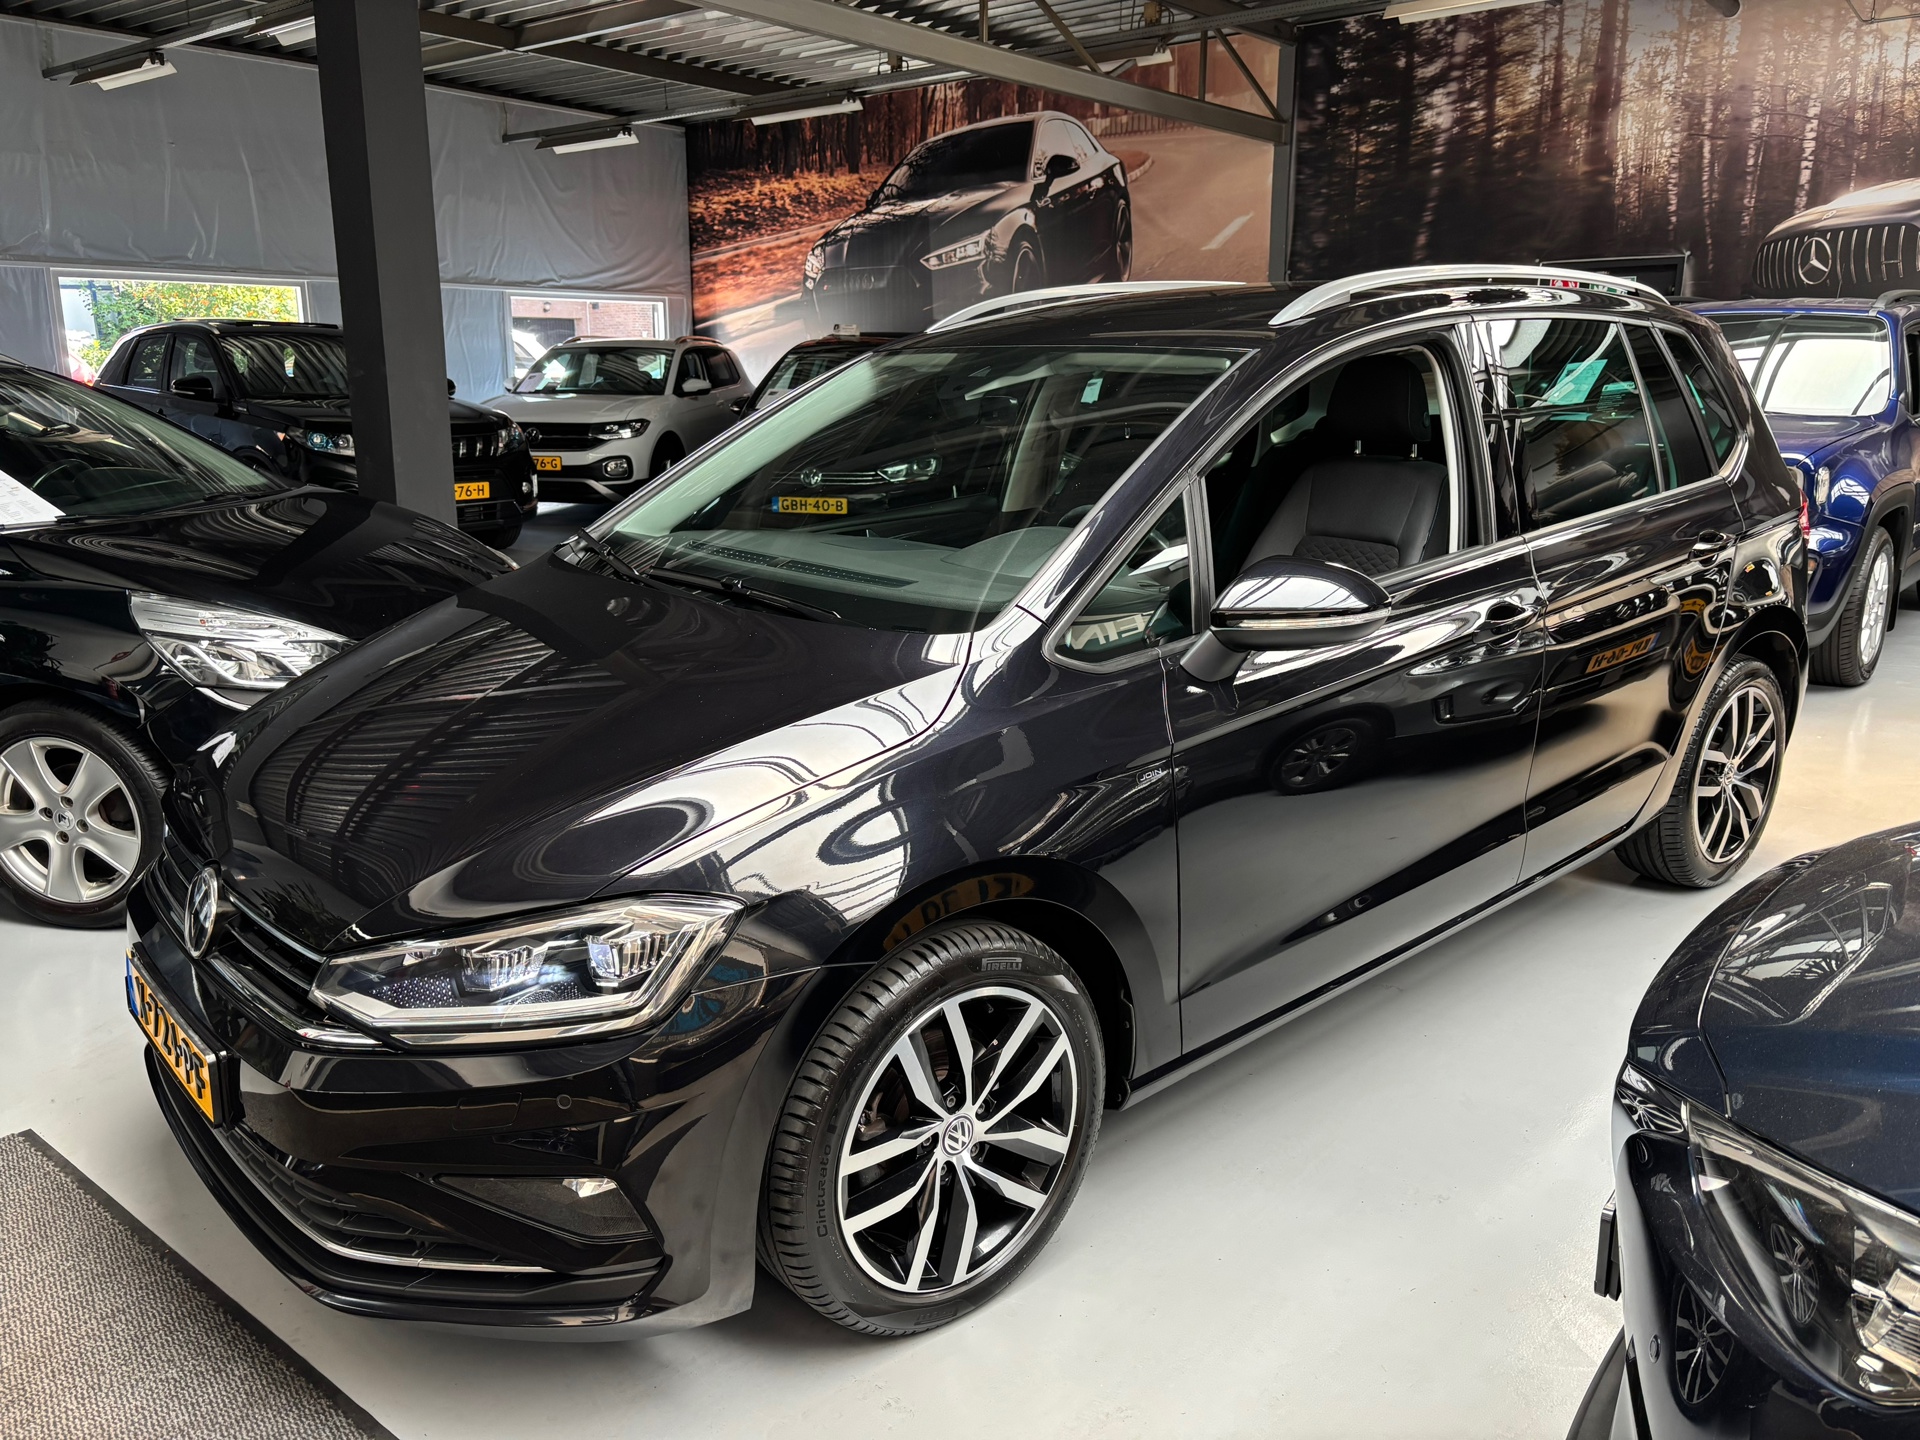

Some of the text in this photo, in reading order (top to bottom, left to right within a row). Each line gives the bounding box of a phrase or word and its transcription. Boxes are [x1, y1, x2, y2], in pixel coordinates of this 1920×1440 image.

[781, 498, 844, 512] GBH-40-B
[1139, 767, 1163, 782] JOIN
[980, 956, 1023, 971] PIRELLI
[135, 976, 206, 1099] X-724-PF
[815, 1143, 832, 1238] Cinturato
